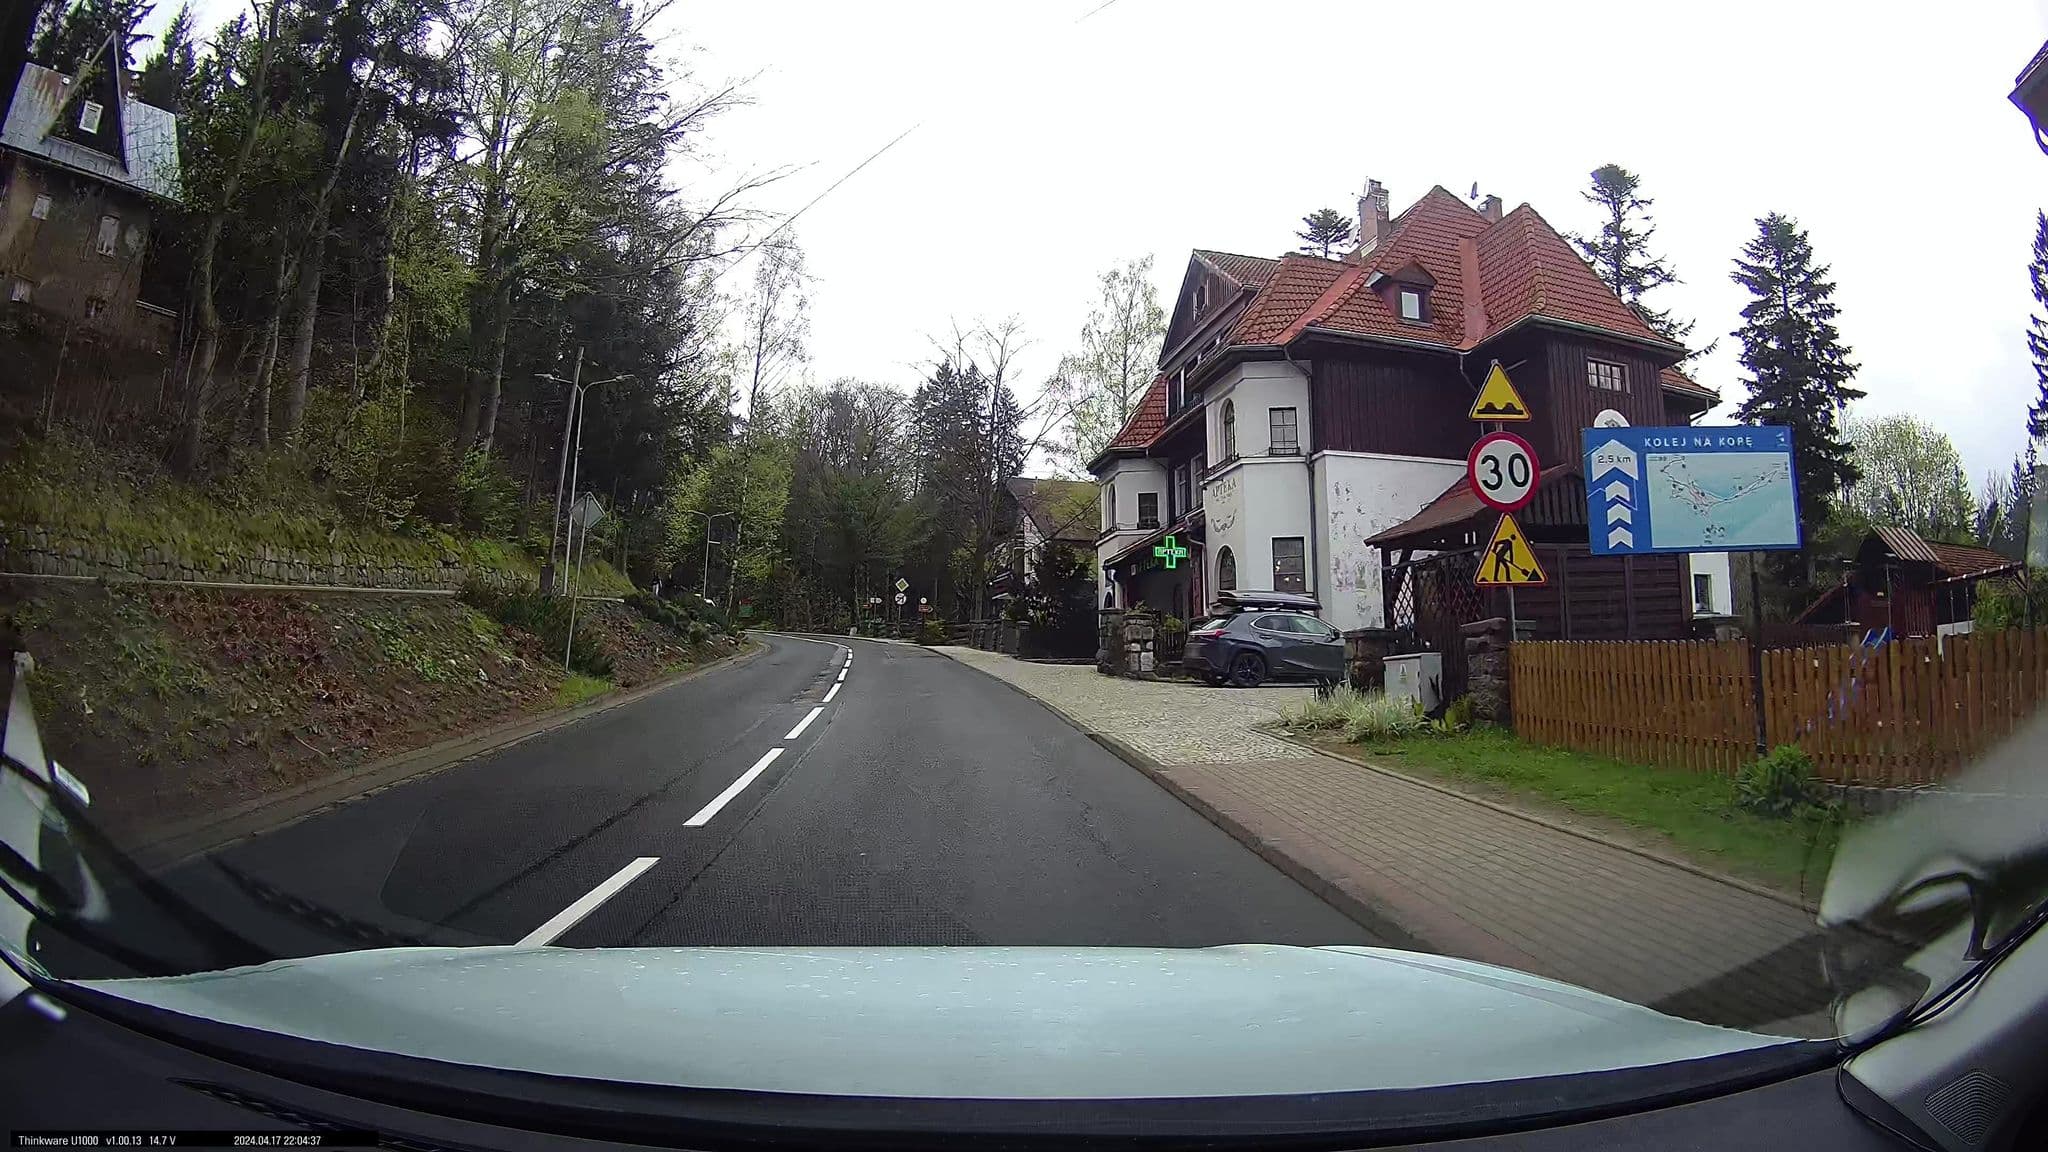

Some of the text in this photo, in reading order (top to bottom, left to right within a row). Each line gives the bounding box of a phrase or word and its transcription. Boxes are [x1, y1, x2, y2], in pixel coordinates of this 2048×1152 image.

[1644, 437, 1686, 447] KOLEJ
[1694, 437, 1711, 447] NA
[1616, 455, 1631, 463] km
[1480, 452, 1530, 491] 30
